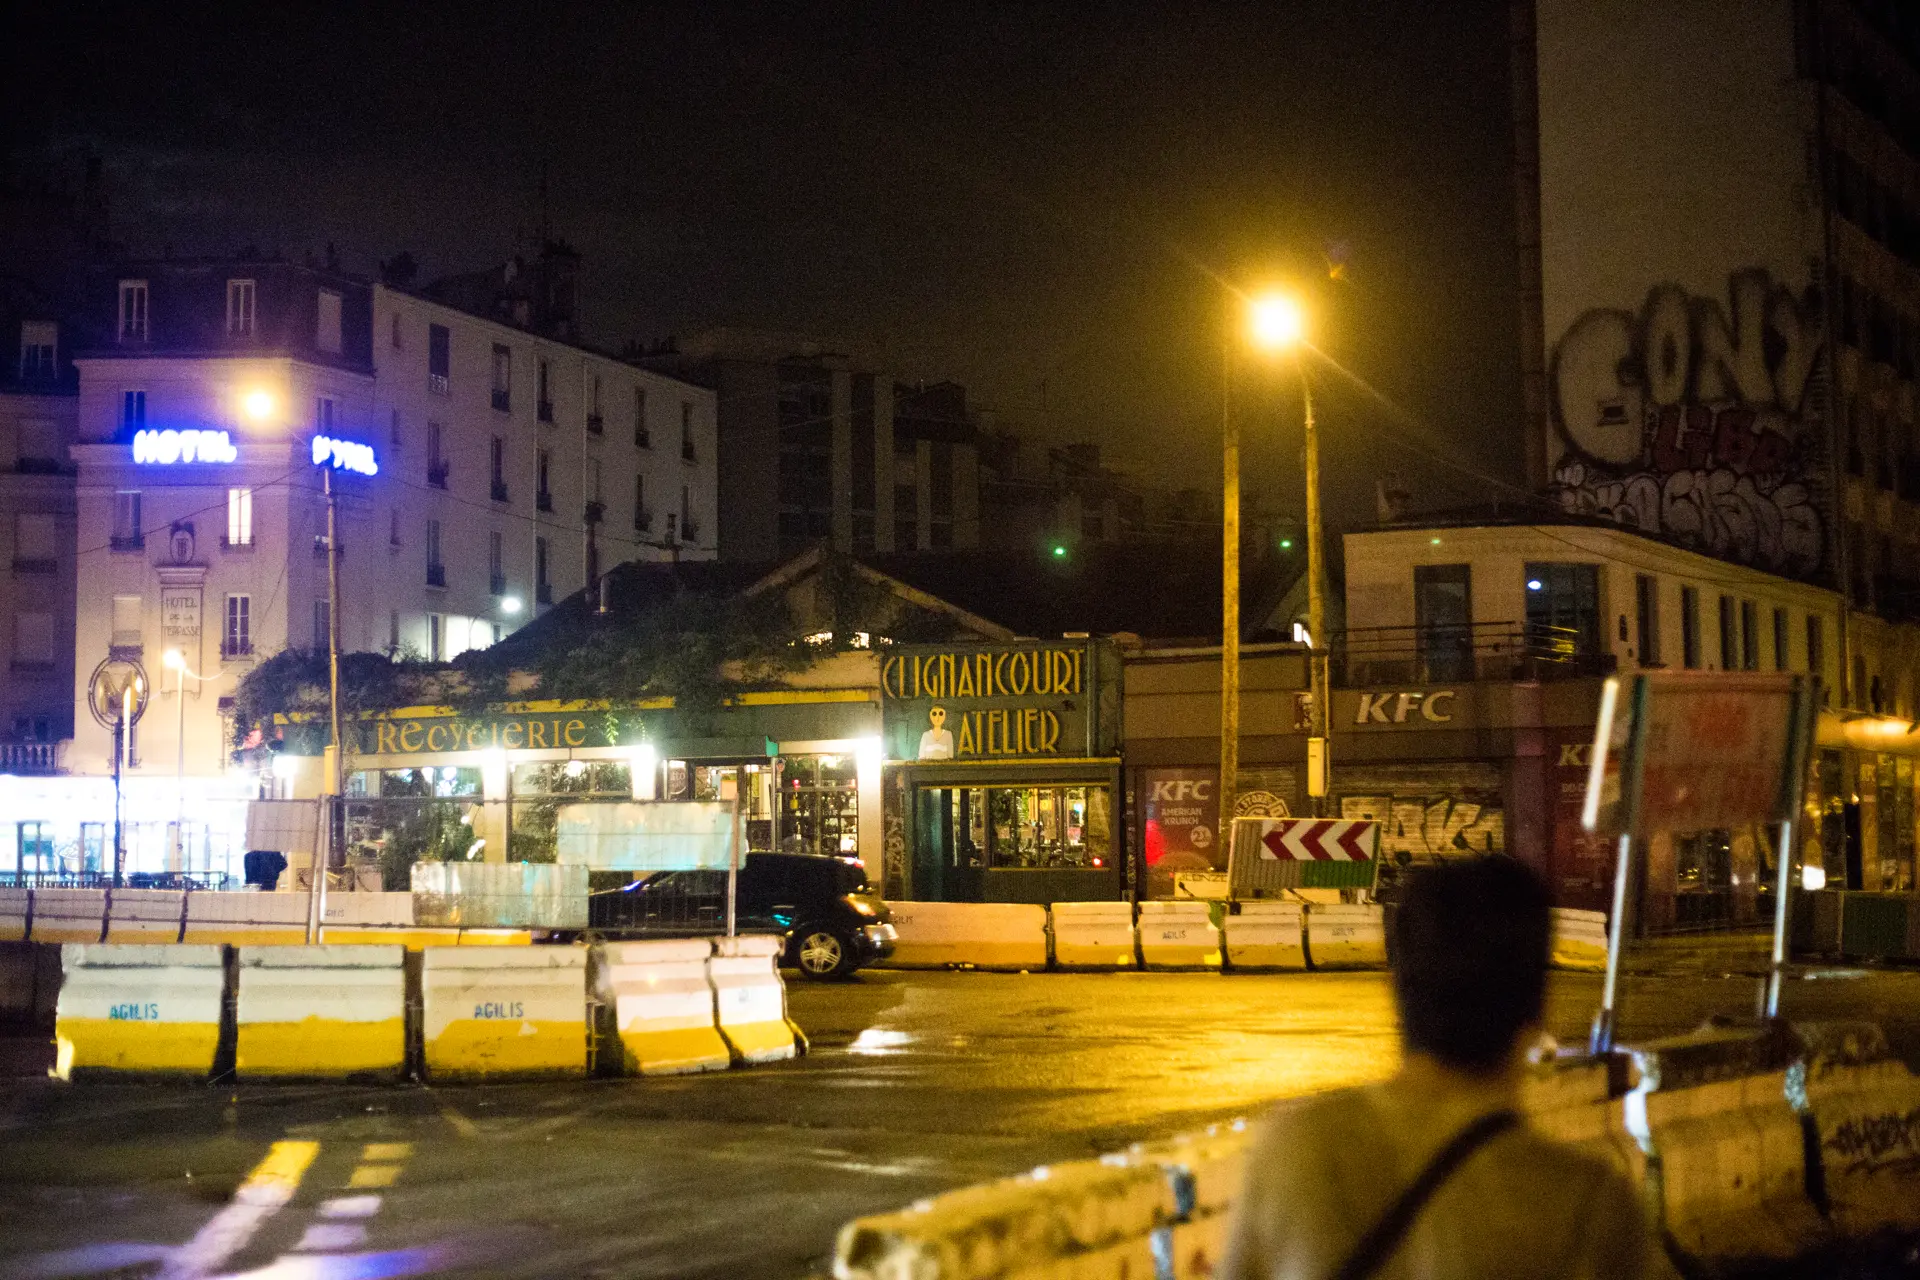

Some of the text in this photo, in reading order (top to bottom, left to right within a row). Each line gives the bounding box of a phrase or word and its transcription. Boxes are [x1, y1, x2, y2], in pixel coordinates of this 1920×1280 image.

[133, 429, 237, 464] HOTEL
[165, 597, 197, 608] HOTEL
[882, 649, 1084, 699] CLIGNANCOURT
[1357, 691, 1455, 723] KFC
[958, 709, 1060, 754] ATELIER
[1151, 780, 1212, 801] KFC
[1161, 807, 1202, 816] AMERICAN
[1164, 817, 1199, 825] KRUNCH
[109, 1003, 159, 1019] AGILIS
[474, 1002, 524, 1018] AGILIS
